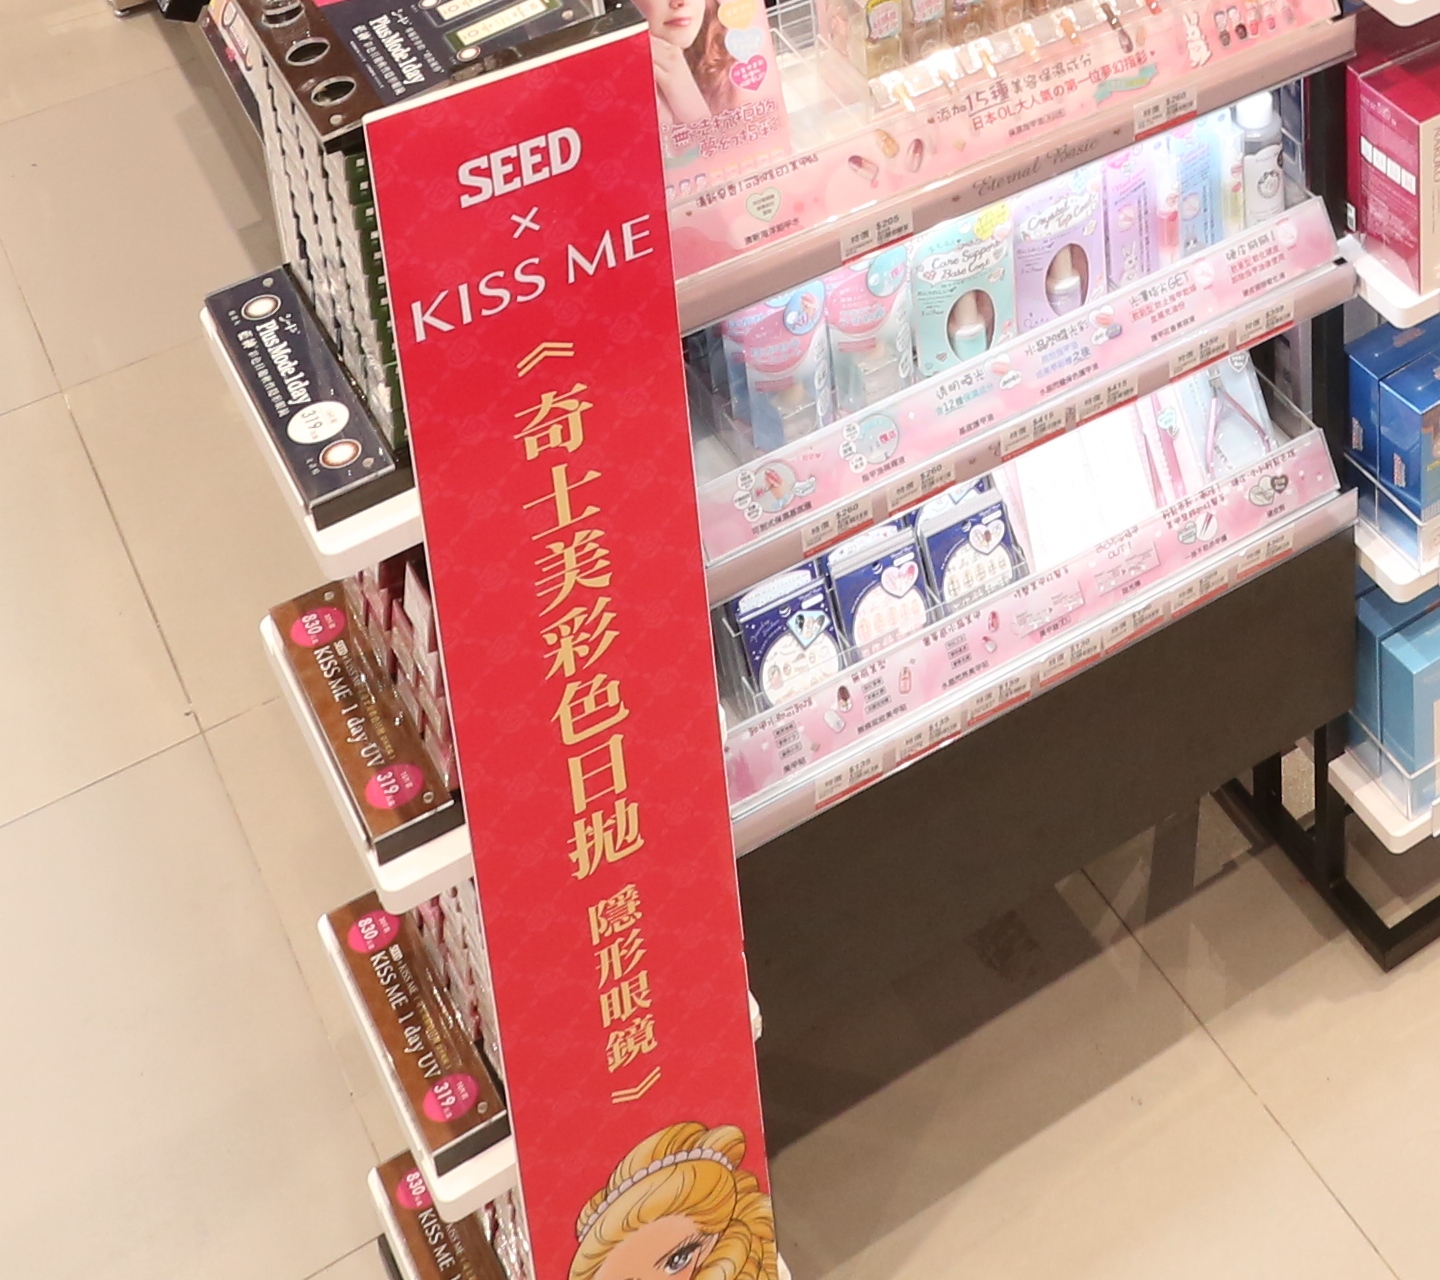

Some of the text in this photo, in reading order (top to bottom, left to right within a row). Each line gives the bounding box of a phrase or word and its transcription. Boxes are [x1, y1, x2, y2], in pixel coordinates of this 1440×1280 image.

[458, 124, 582, 209] SEED
[972, 139, 1098, 197] Eternal Basic
[410, 214, 656, 343] KISS ME
[301, 613, 323, 635] 830
[313, 645, 340, 679] KISS
[328, 676, 354, 703] ME
[347, 716, 368, 743] day
[360, 740, 385, 767] UV
[513, 340, 662, 1106] 《奇士美彩色日拋 隱形眼鏡》
[377, 771, 401, 795] 319
[359, 922, 381, 944] 830
[371, 954, 443, 1076] KISS ME 1 day UV
[435, 1080, 459, 1104] 319
